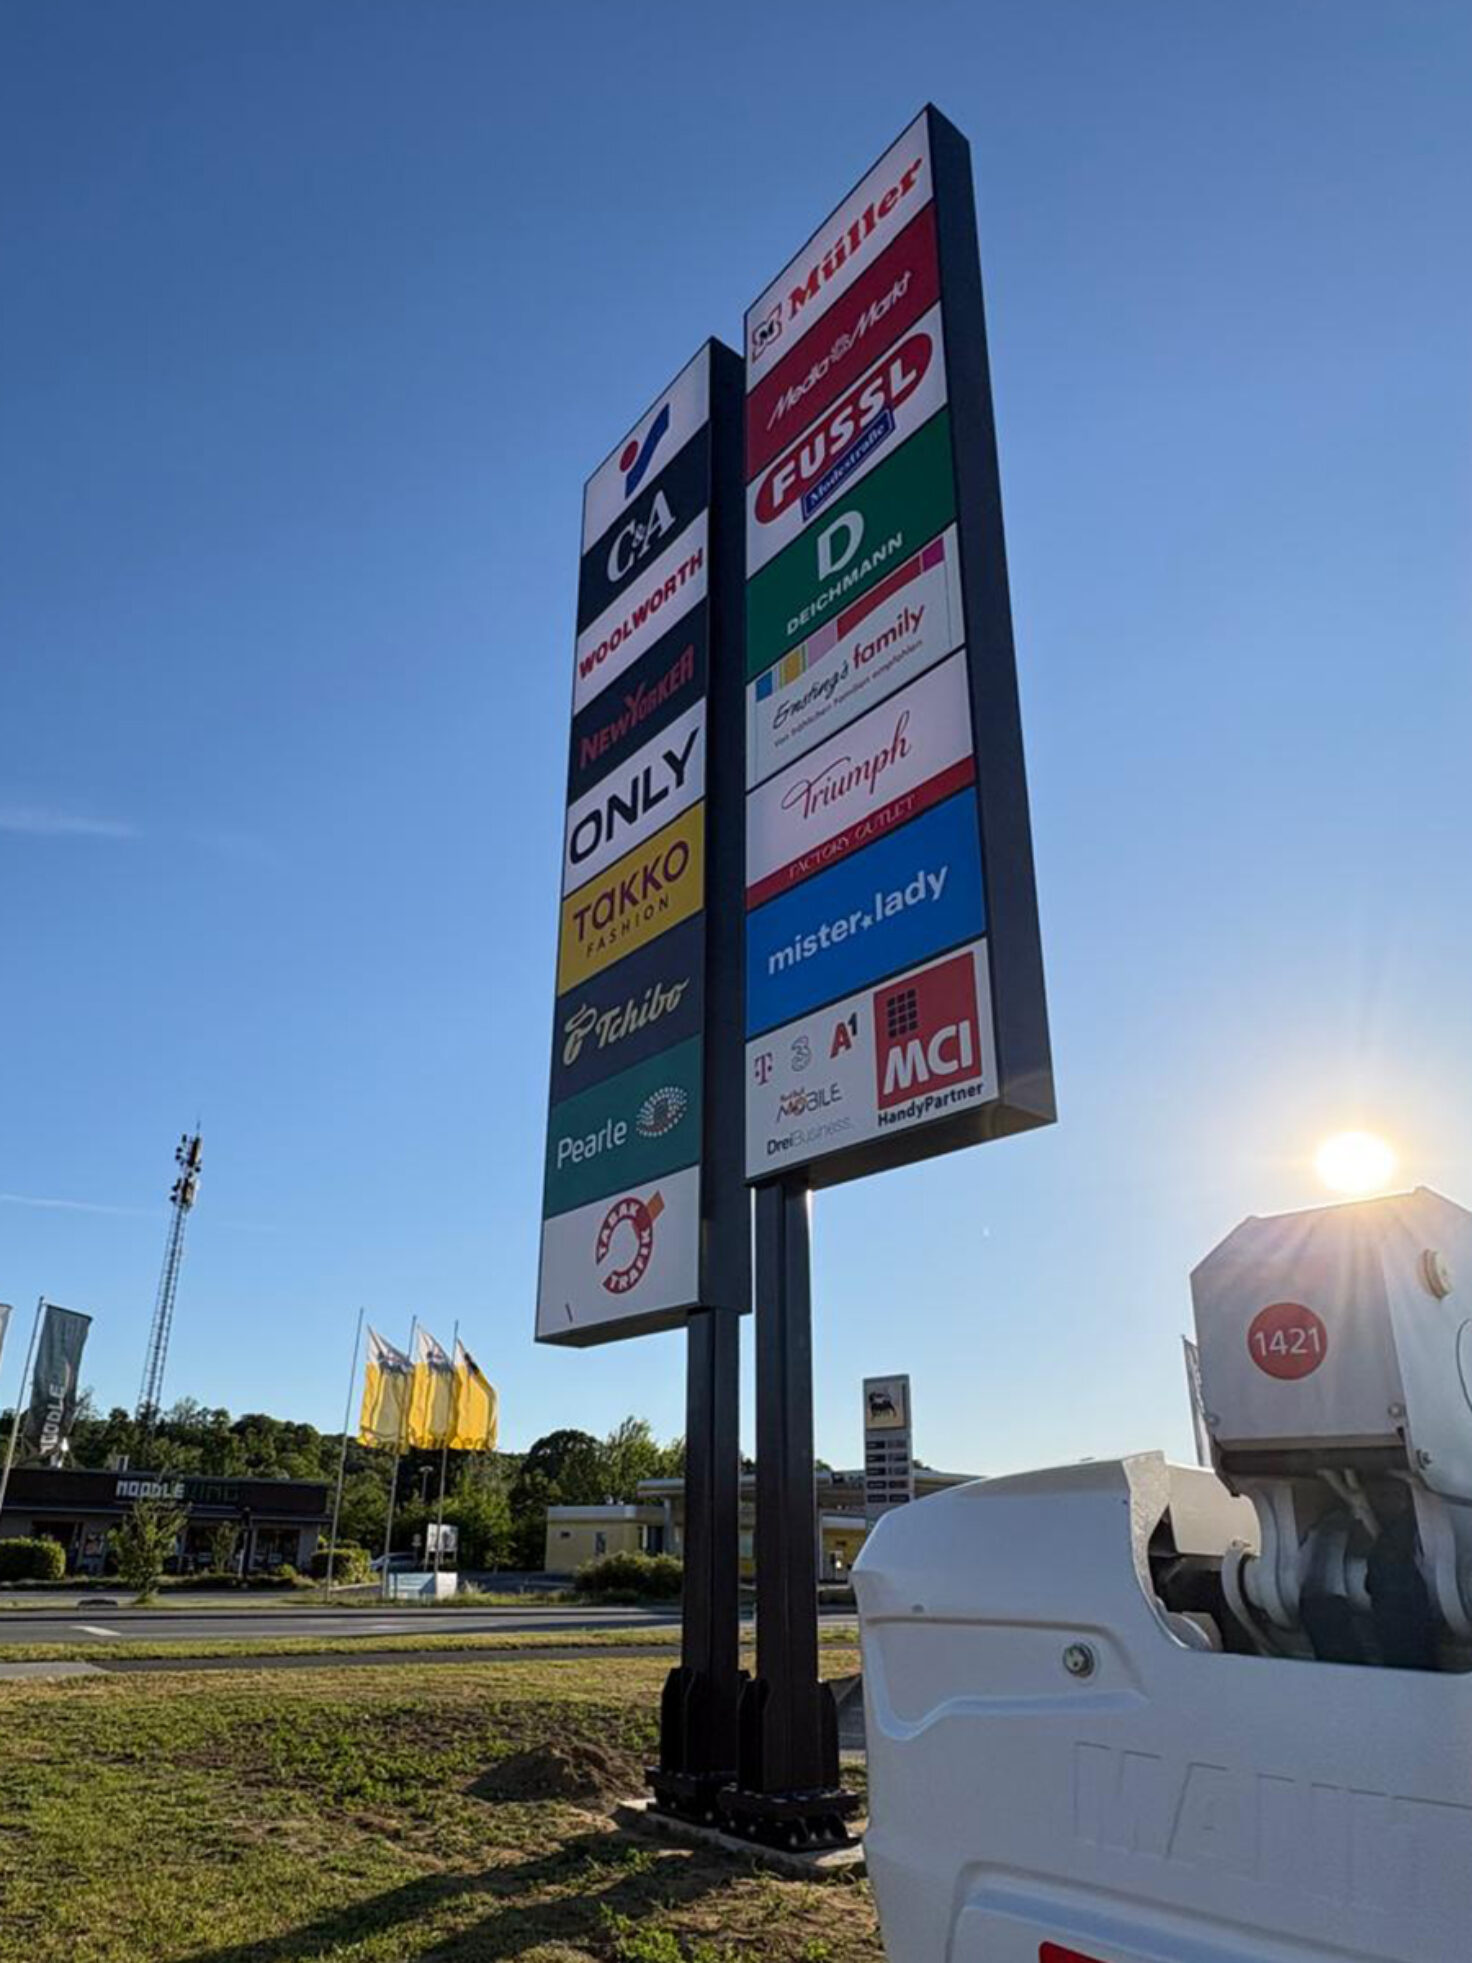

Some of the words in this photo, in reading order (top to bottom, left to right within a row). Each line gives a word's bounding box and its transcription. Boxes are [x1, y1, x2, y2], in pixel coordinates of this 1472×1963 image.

[788, 157, 922, 320] Müller
[773, 358, 917, 508] FUSSL
[607, 489, 676, 583] C&A
[817, 510, 864, 581] D
[579, 547, 703, 680] WOOLWORTH
[786, 532, 903, 635] DEICHMANN
[853, 605, 925, 669] family
[570, 727, 700, 865] ONLY
[781, 710, 912, 819] Triumph
[788, 836, 850, 880] FACTORY
[855, 795, 914, 838] OUTLET
[586, 893, 670, 958] FASHION
[595, 976, 690, 1048] Tchibo
[830, 1012, 858, 1059] A1
[883, 1020, 973, 1095] MCI
[878, 1083, 984, 1128] HandyPartner
[557, 1118, 628, 1170] Pearle
[597, 1202, 640, 1257] TABAK
[608, 1229, 651, 1291] TRAFIK
[1254, 1326, 1320, 1357] 1421
[116, 1480, 185, 1500] NOODLE
